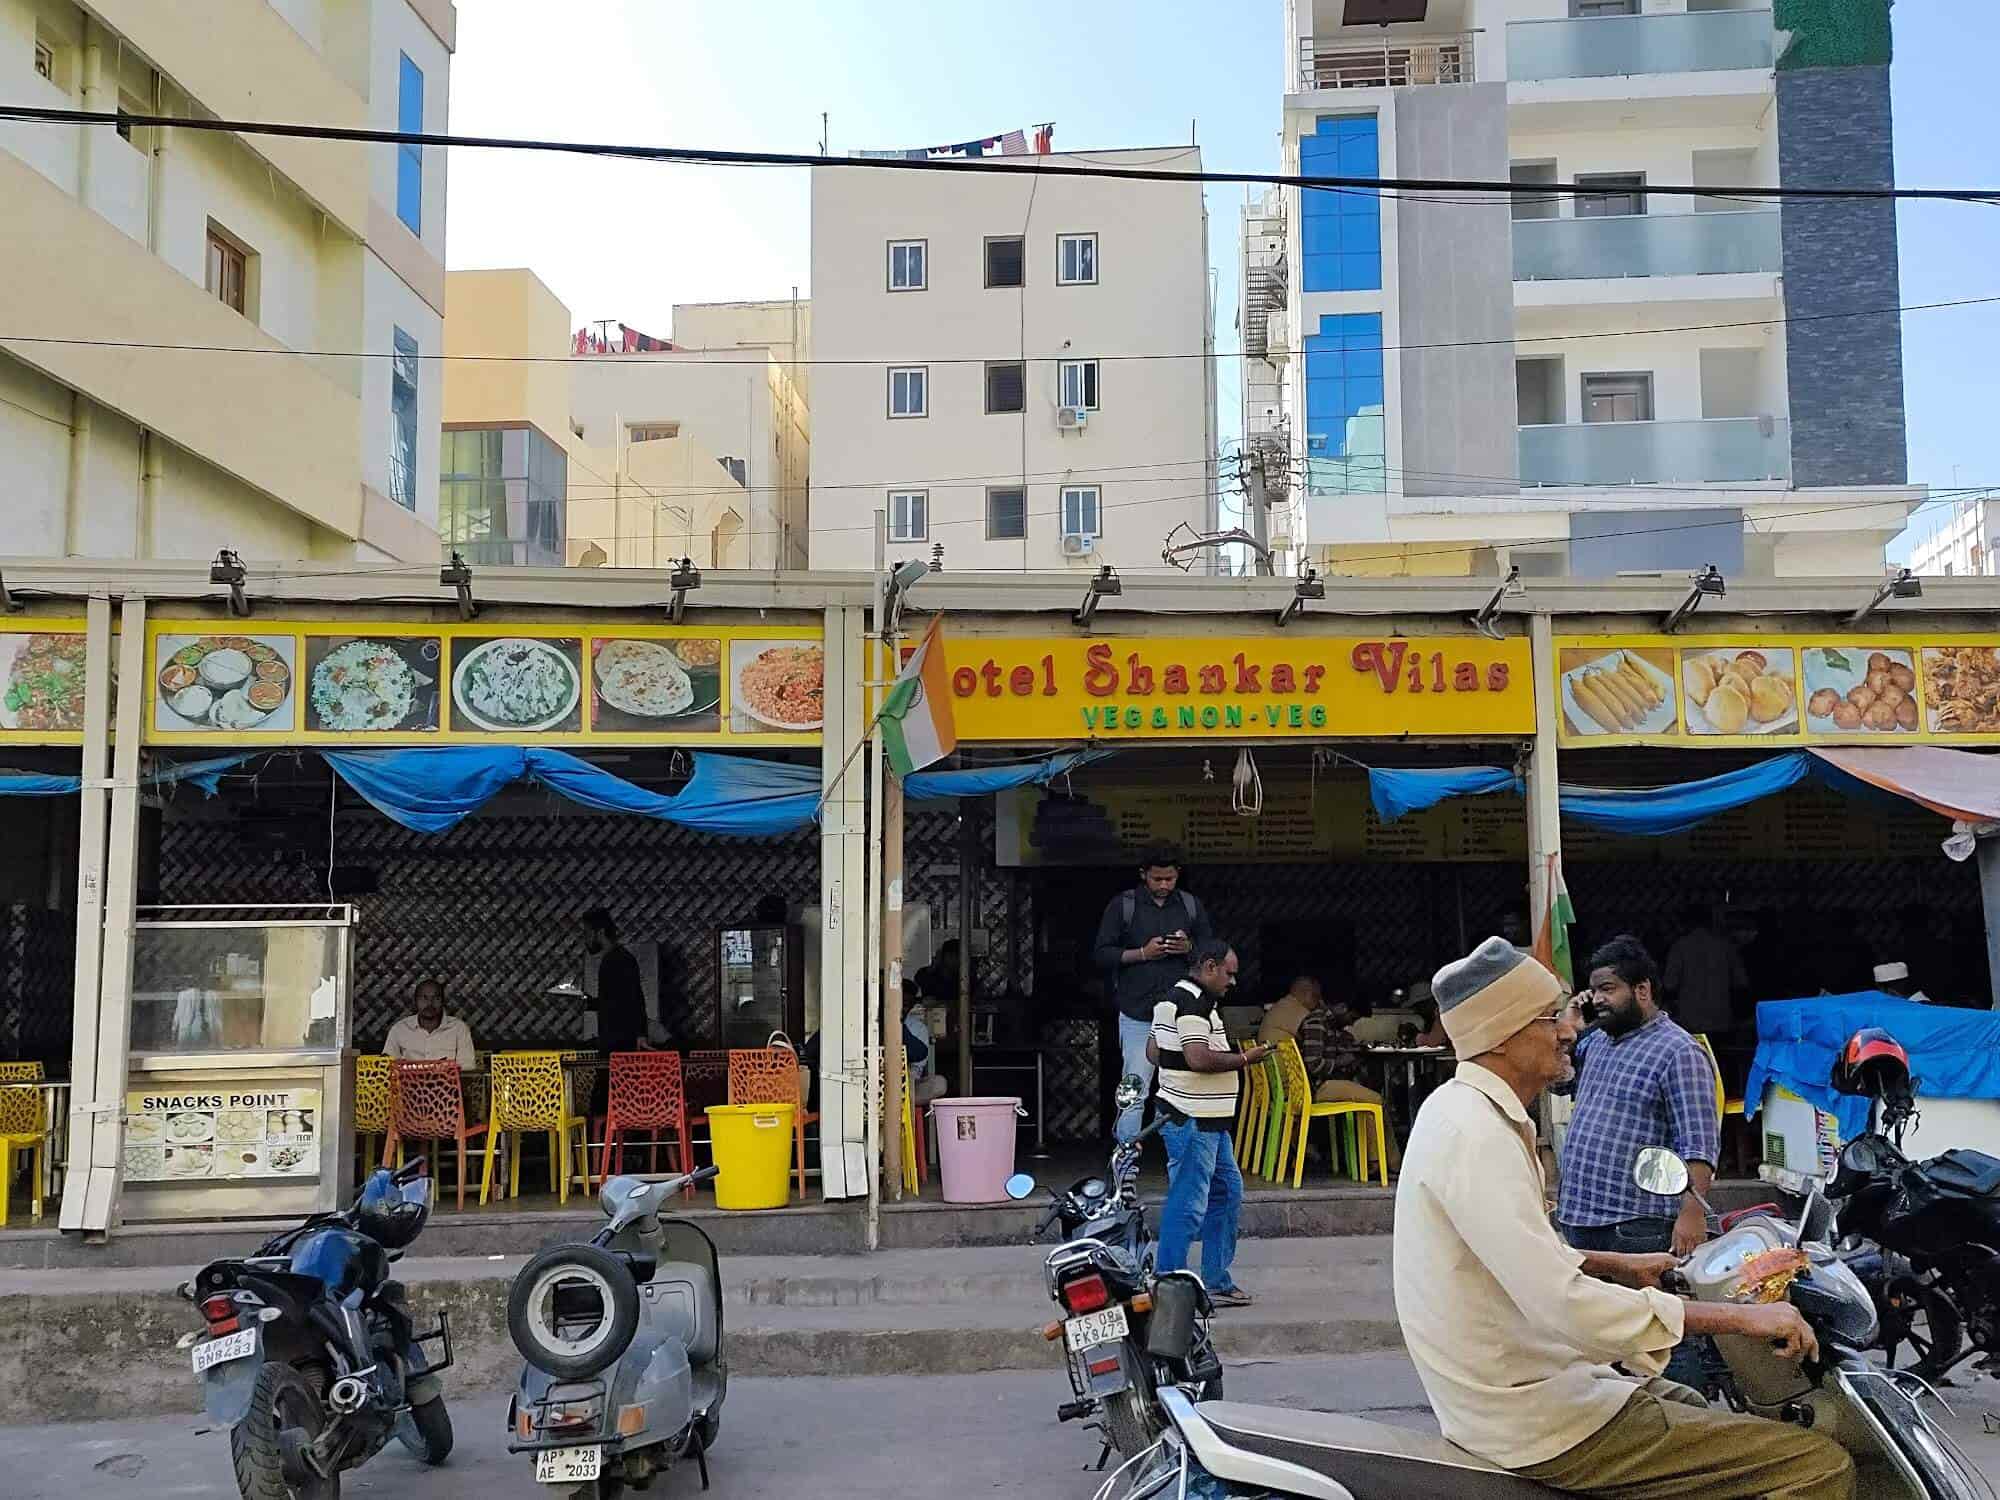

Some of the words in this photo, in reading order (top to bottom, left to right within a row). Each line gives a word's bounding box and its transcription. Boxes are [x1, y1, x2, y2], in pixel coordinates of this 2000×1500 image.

[901, 648, 1058, 697] otel
[1084, 643, 1327, 698] Shankar
[1351, 641, 1510, 695] Vilas
[143, 1095, 222, 1110] SNACKS
[229, 1094, 289, 1107] POINT
[1075, 1319, 1092, 1332] TS
[542, 1451, 557, 1464] AP
[582, 1450, 595, 1463] 28
[539, 1466, 555, 1479] AE
[568, 1464, 596, 1476] 2033
